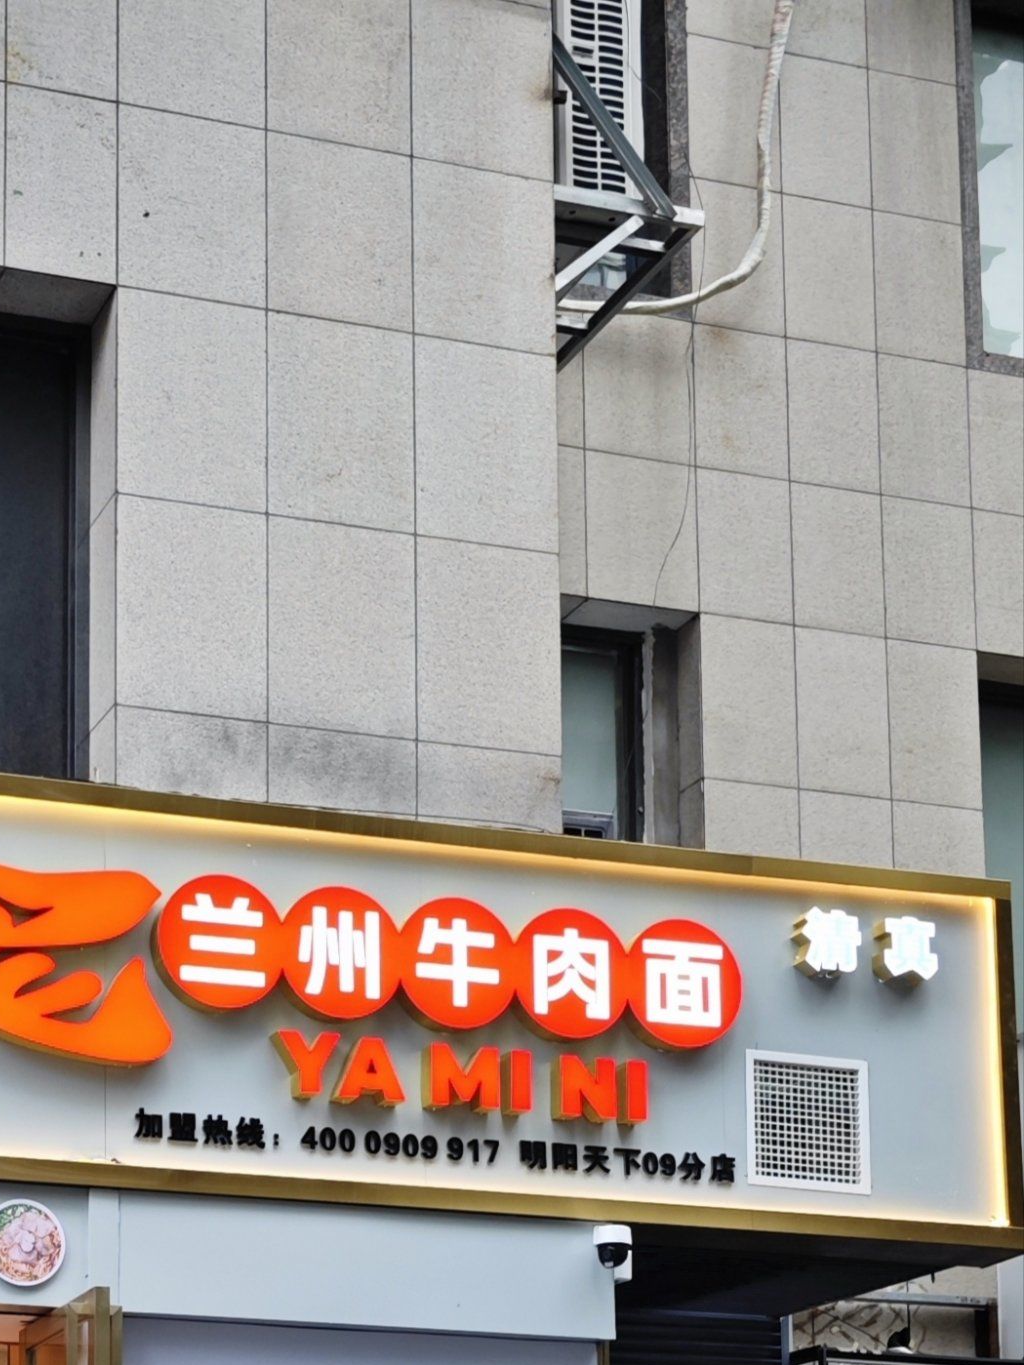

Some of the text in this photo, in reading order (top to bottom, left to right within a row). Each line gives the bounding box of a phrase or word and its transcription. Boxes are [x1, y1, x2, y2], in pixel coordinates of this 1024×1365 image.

[178, 891, 726, 1029] 兰州牛肉面
[518, 1138, 737, 1184] 明阳天下09分店
